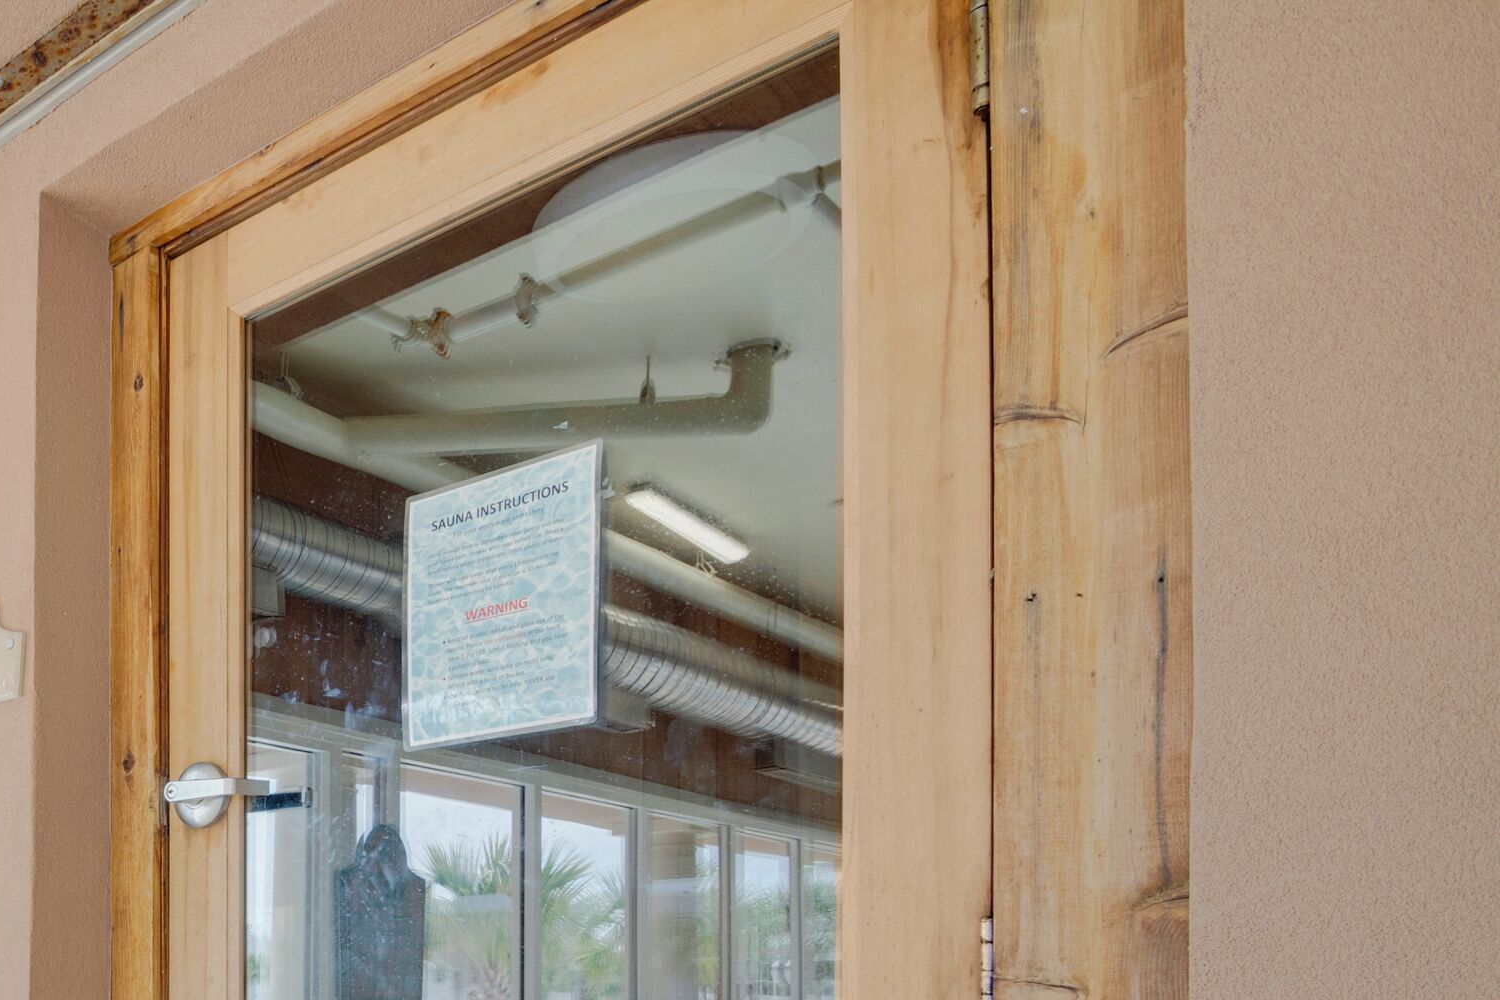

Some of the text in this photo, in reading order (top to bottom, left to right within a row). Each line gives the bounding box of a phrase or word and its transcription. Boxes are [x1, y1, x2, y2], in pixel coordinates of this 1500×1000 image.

[431, 480, 569, 532] SAUNA INSTRUCTIONS
[465, 596, 528, 621] WARNING
